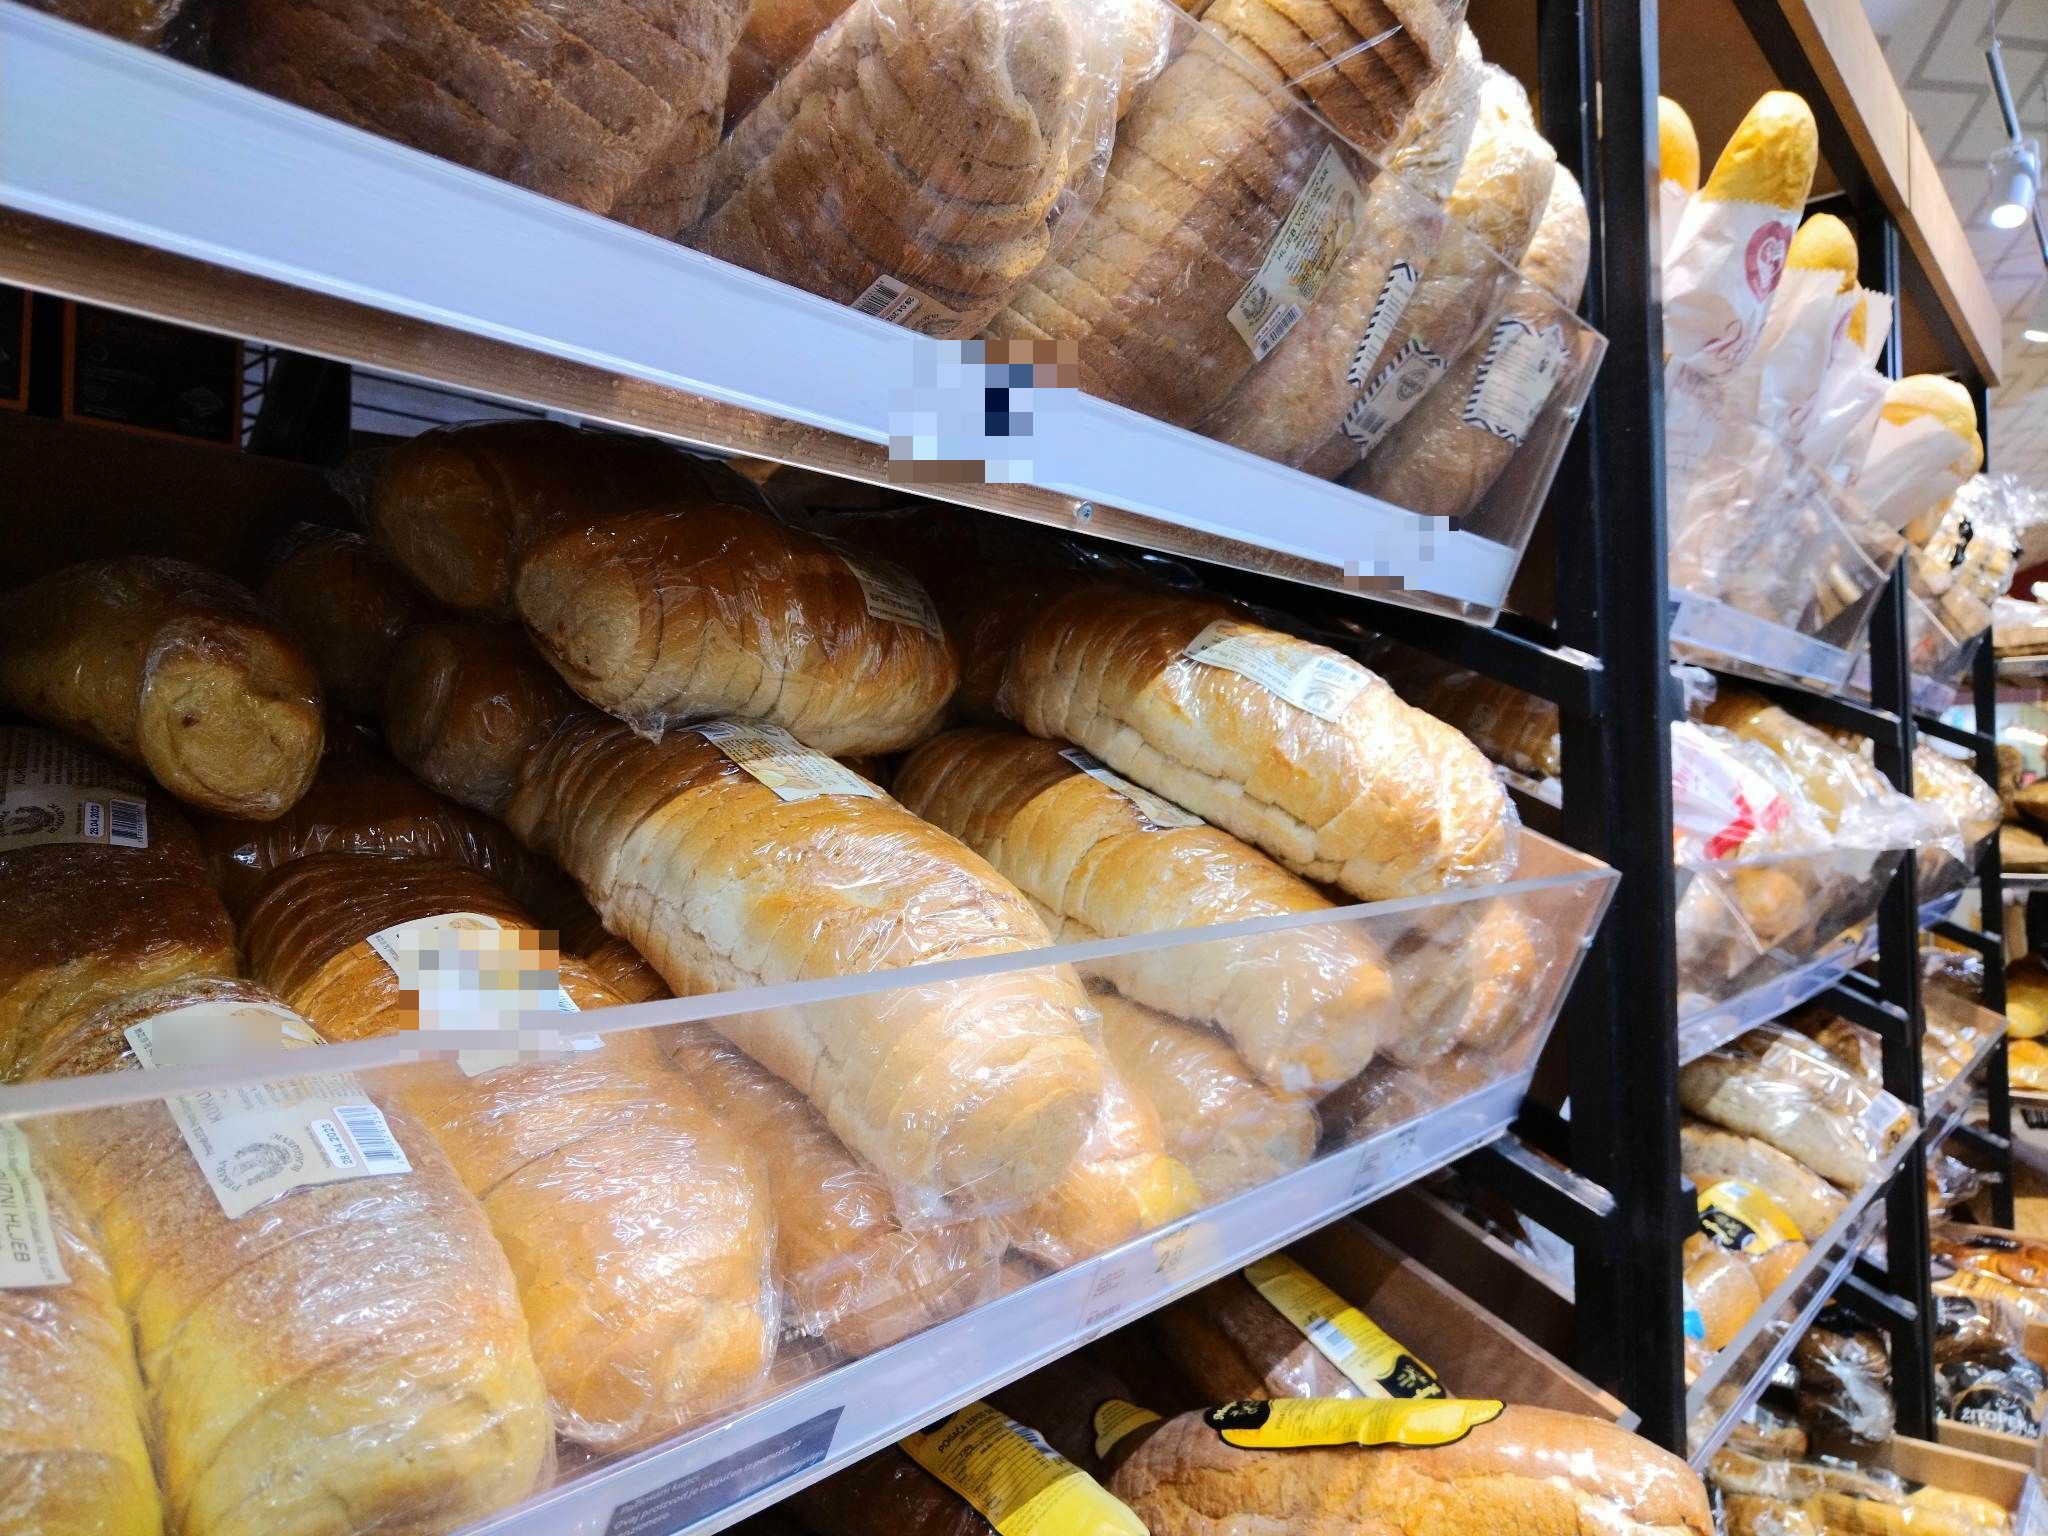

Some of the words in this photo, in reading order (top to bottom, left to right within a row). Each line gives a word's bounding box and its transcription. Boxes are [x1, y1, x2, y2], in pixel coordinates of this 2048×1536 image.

[1275, 227, 1297, 261] HLJEB
[321, 1122, 353, 1166] 28.04.2023
[5, 1213, 31, 1263] HLJEB
[937, 1423, 967, 1453] POGAČA
[614, 1511, 640, 1530] Ovaj
[640, 1490, 689, 1521] proizvod
